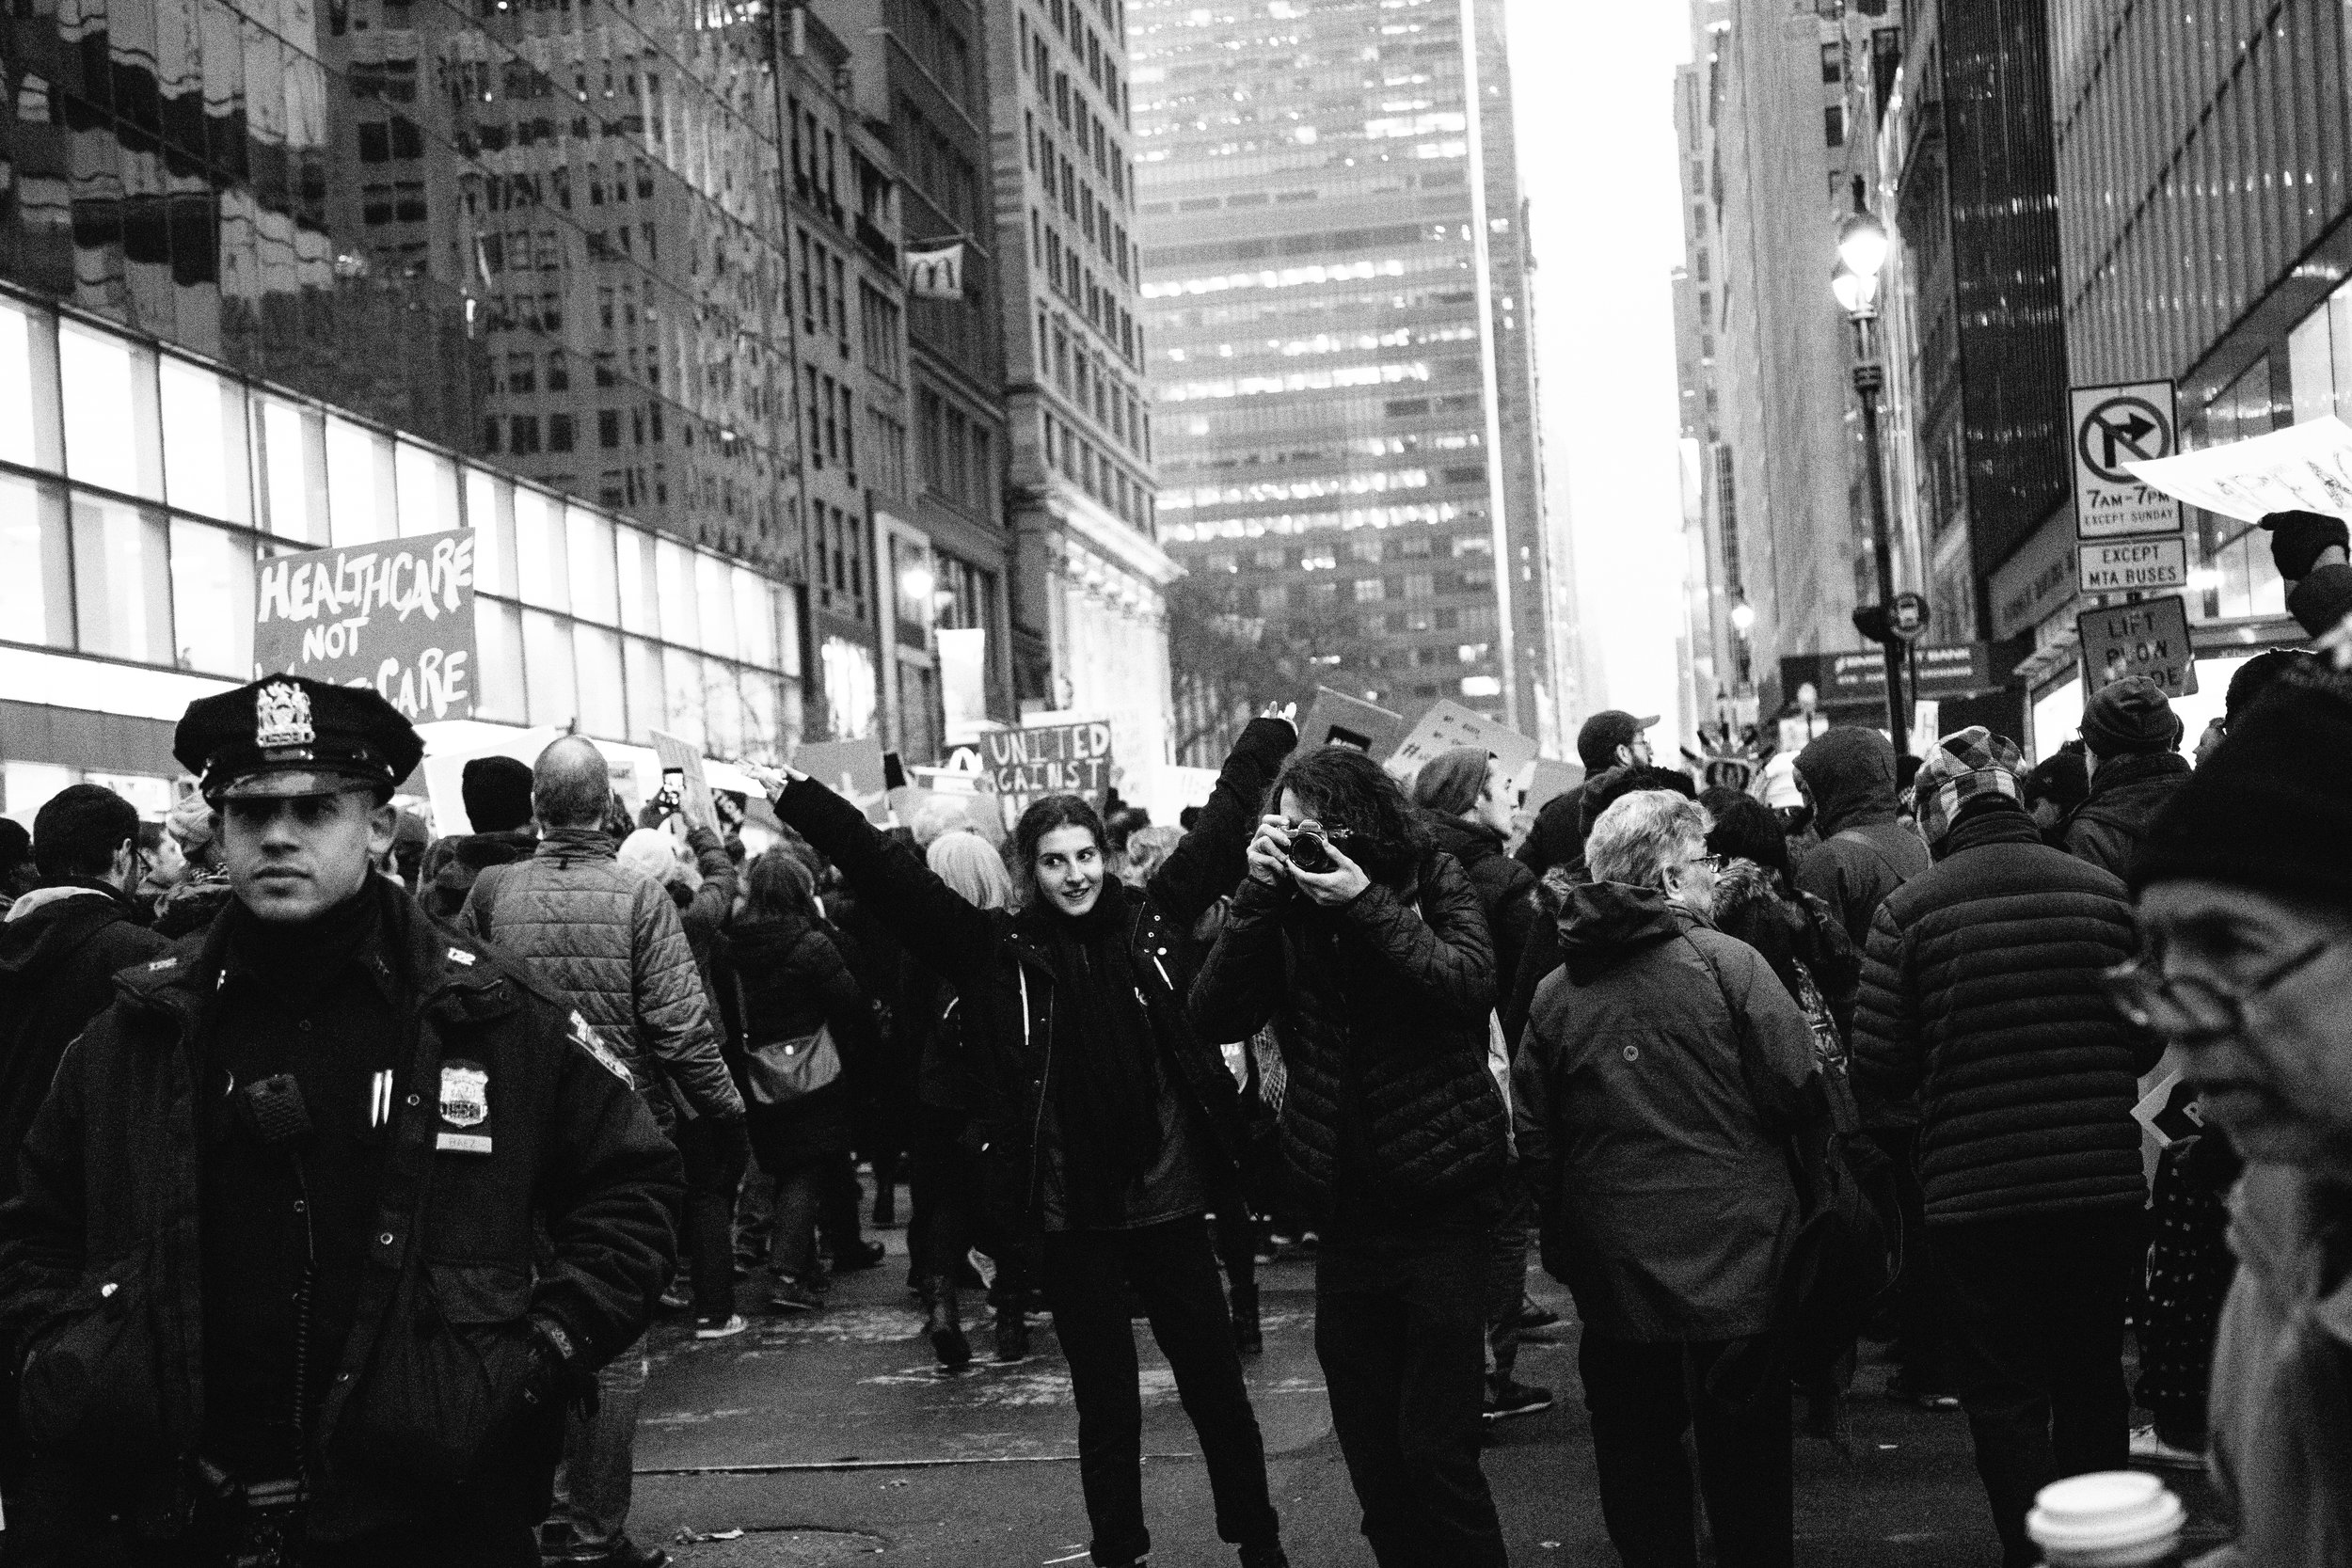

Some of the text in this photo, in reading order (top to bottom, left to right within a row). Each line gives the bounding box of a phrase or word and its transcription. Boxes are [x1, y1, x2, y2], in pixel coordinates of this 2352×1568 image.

[2084, 508, 2173, 526] EXCEPT SUNDAY
[2103, 546, 2159, 563] EXCEPT
[258, 535, 473, 623] HEALTHCARE
[2090, 565, 2177, 586] MTA BUSES
[302, 616, 370, 663] NOT
[990, 722, 1111, 766] UNITED
